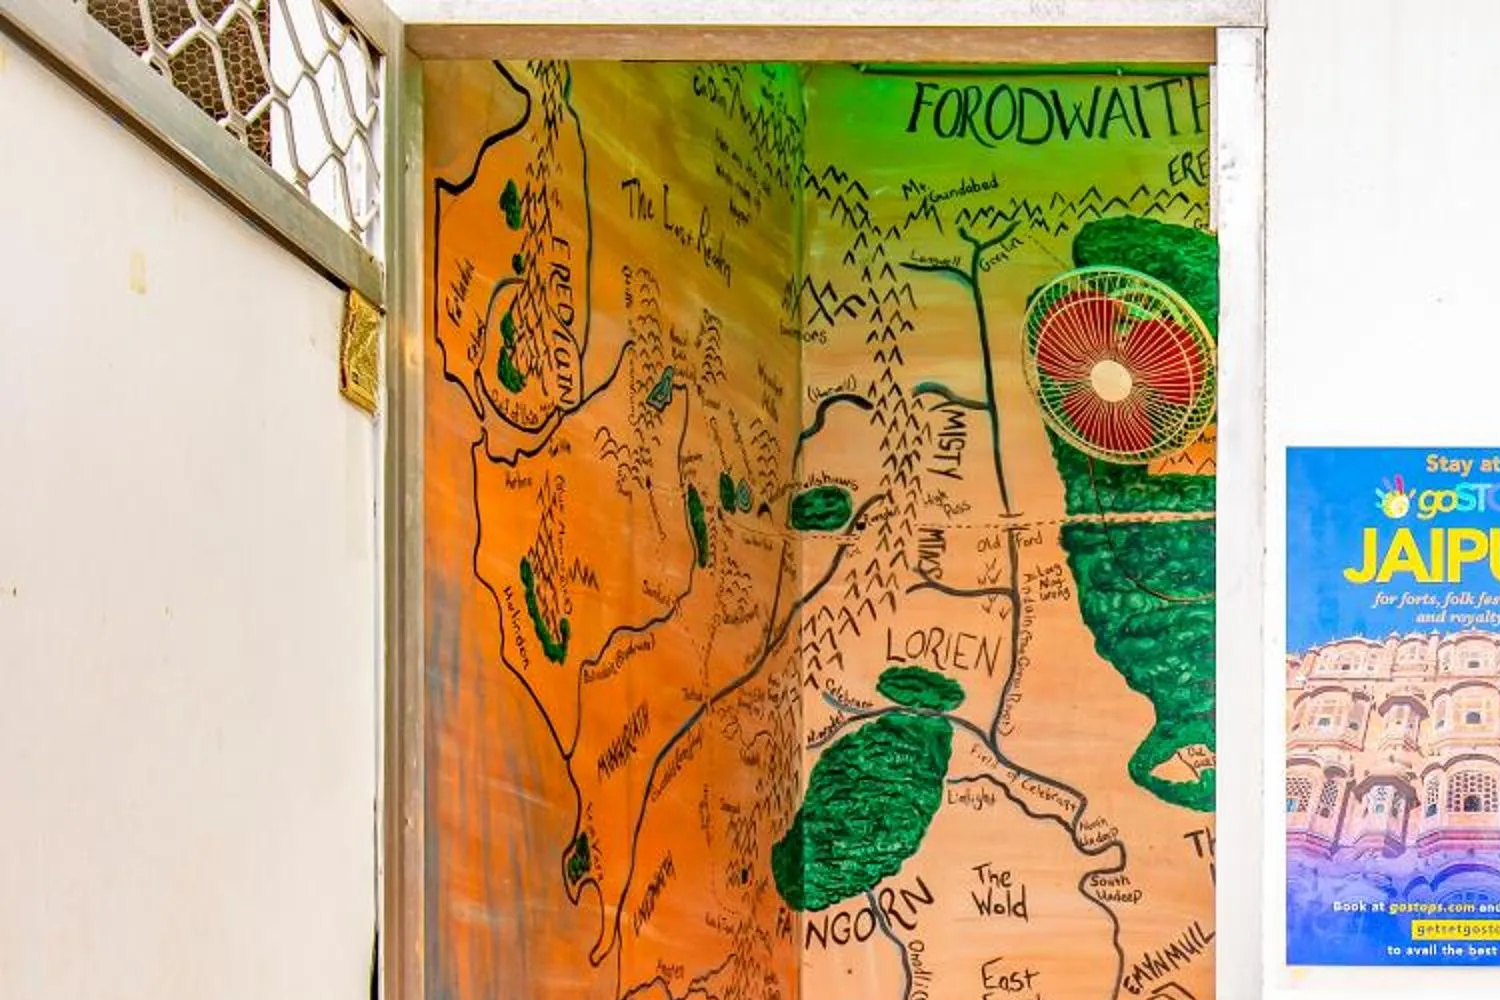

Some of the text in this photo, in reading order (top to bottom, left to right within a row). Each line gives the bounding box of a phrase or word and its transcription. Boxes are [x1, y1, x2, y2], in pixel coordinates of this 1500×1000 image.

[621, 177, 656, 223] The
[926, 409, 968, 481] MISTY
[1426, 454, 1473, 477] Stay
[977, 530, 1043, 553] Old Ford
[1371, 591, 1395, 608] for
[1398, 591, 1441, 609] forts,
[1443, 591, 1474, 609] folk
[1416, 610, 1447, 624] and
[886, 626, 1005, 678] LORIEN
[971, 861, 1013, 889] The
[971, 884, 1029, 924] Wold
[1333, 901, 1367, 913] Book
[1371, 902, 1385, 913] at
[1388, 902, 1475, 915] gostops.com
[1387, 945, 1402, 956] to
[1406, 944, 1437, 956] avail
[1441, 945, 1463, 956] the
[1468, 945, 1497, 956] best
[981, 956, 1041, 992] East
